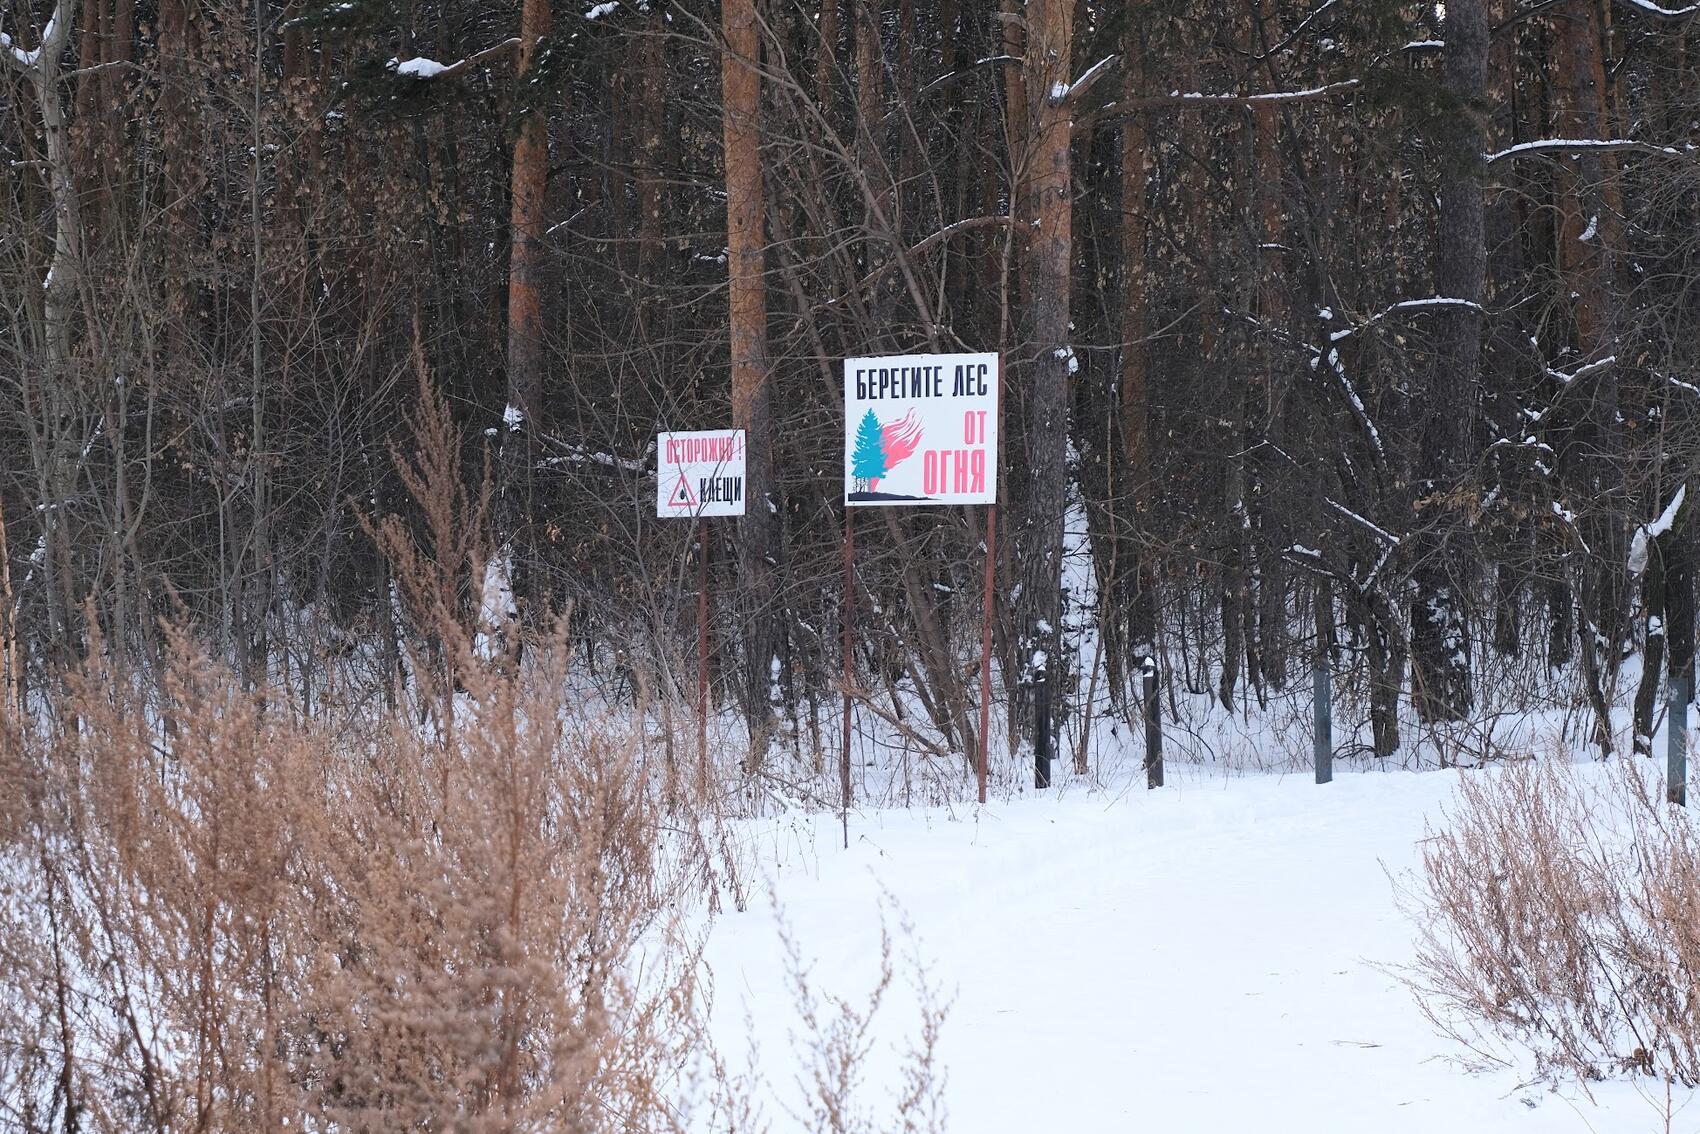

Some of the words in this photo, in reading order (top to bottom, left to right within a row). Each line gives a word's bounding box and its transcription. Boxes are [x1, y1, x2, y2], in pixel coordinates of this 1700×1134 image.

[856, 366, 943, 400] БЕРЕГИТЕ
[953, 364, 987, 397] ЛЕС
[964, 410, 987, 445] ОТ
[923, 449, 985, 494] ОГНЯ
[700, 476, 741, 505] КЛЕЩИ
